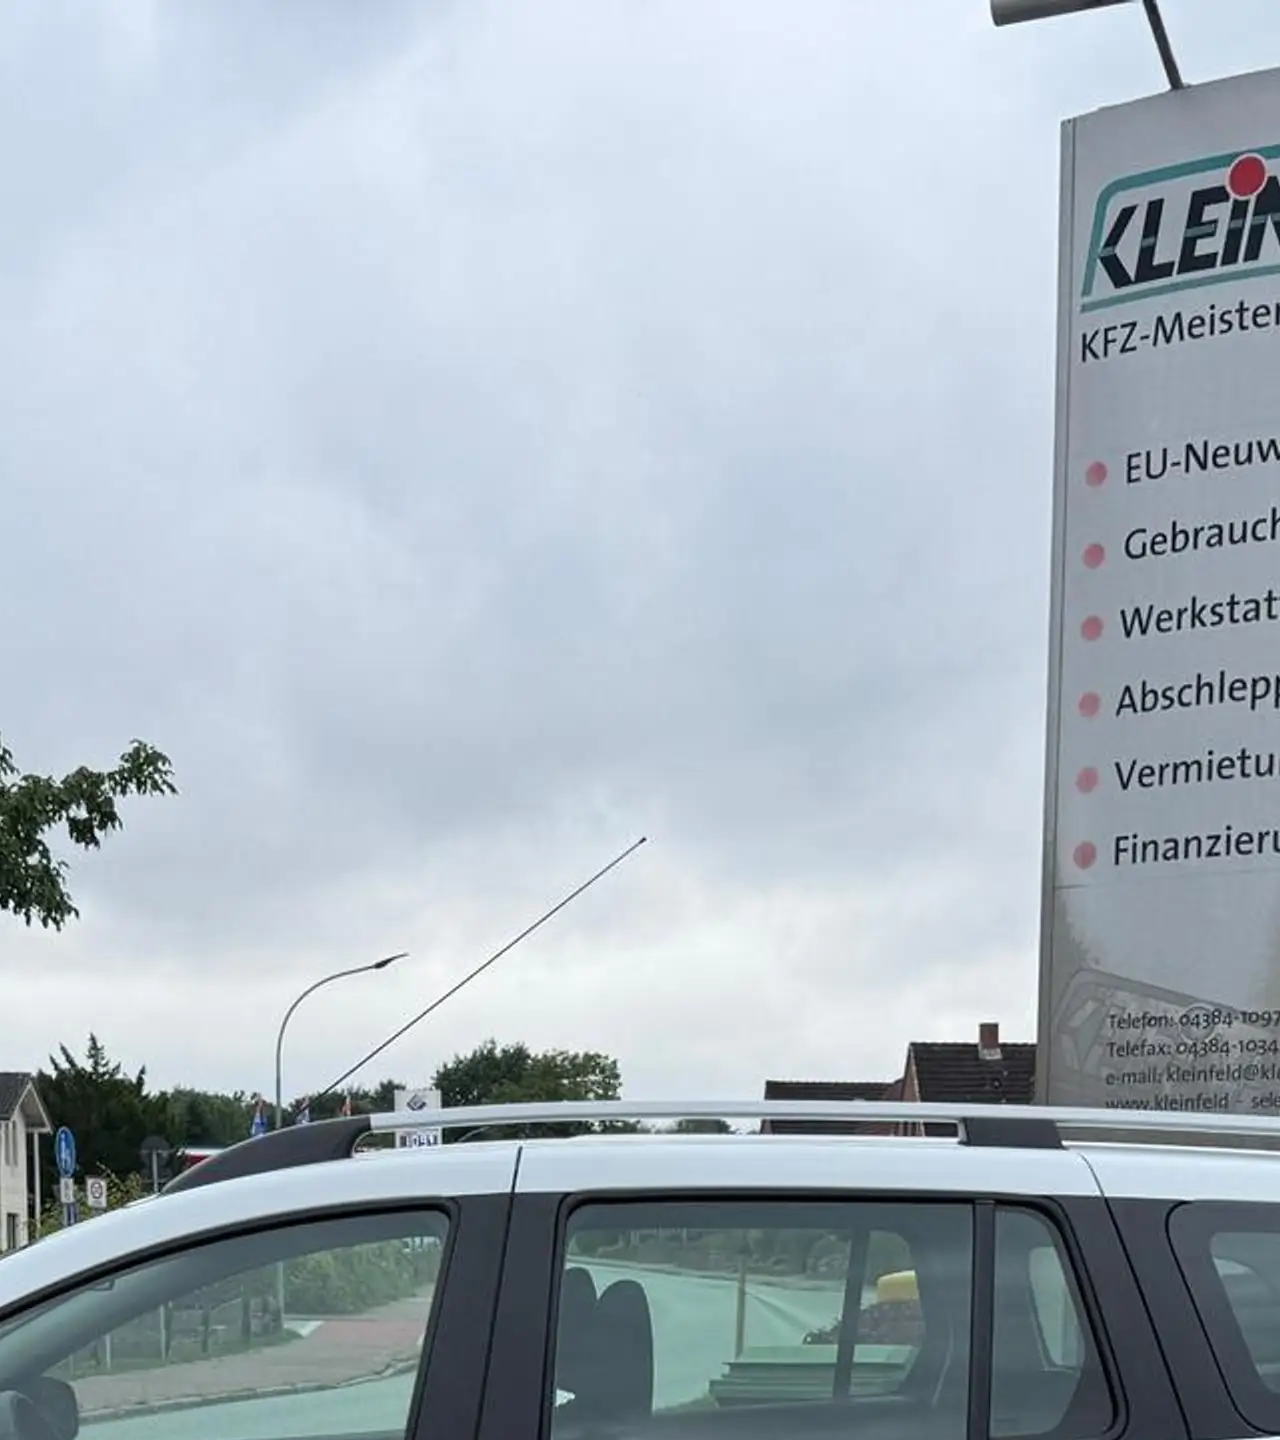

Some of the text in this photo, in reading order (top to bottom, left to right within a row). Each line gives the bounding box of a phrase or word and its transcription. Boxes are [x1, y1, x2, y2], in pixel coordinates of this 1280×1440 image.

[1109, 1010, 1174, 1030] Telefon:
[1107, 1037, 1280, 1058] Telefax: 04384-1034
